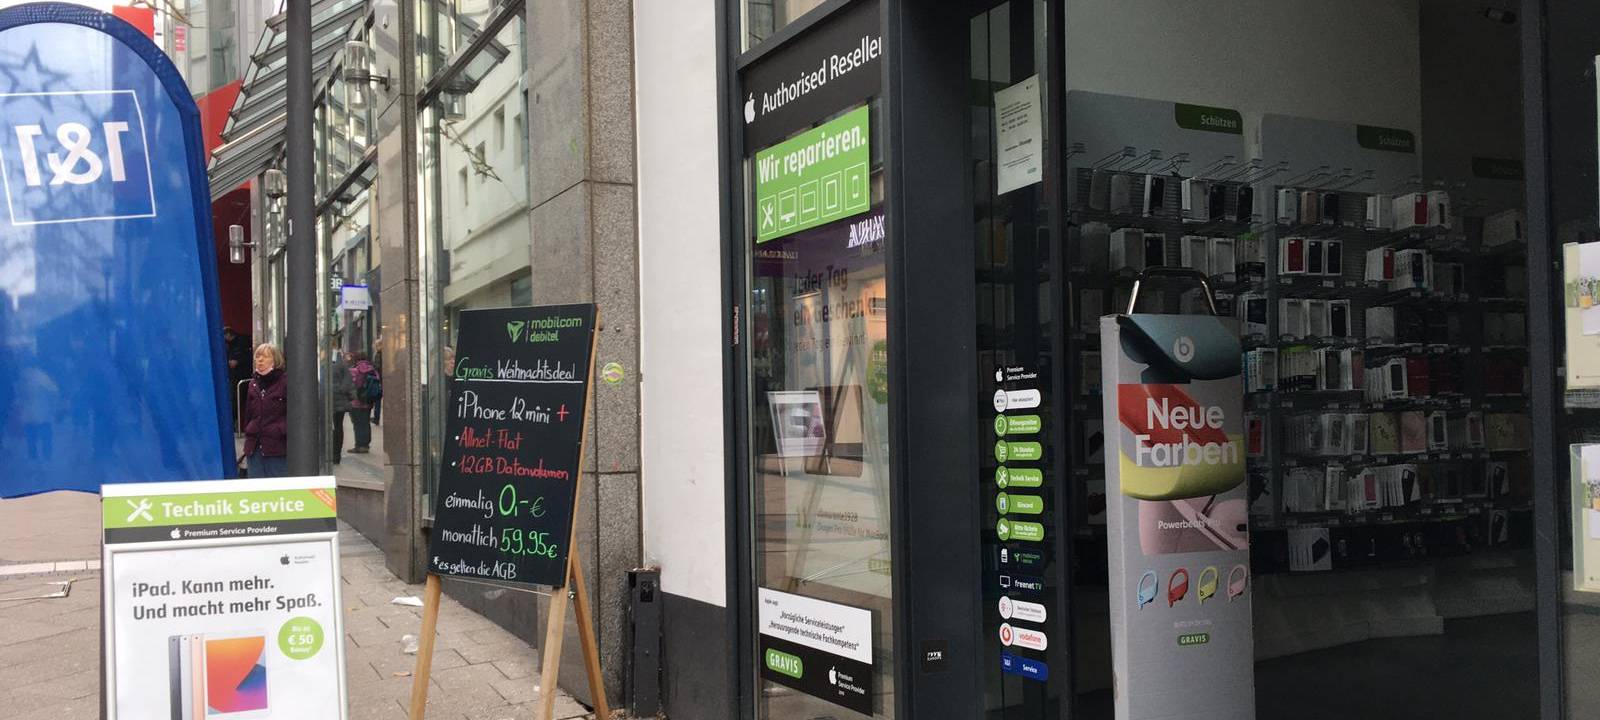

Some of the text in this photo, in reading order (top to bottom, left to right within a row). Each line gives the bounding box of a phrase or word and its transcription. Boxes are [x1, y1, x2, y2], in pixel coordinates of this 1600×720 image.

[762, 59, 826, 115] Authorised
[1200, 114, 1237, 128] Schützen
[758, 125, 866, 184] Wir reparieren.
[826, 264, 848, 291] Tag
[531, 316, 582, 329] mobilcom
[530, 330, 559, 342] debitel
[455, 357, 575, 381] Gravis Weihnachtsdeal
[458, 390, 506, 420] iPhone
[510, 396, 526, 421] 12
[525, 406, 551, 424] mini
[1147, 398, 1225, 430] Neue
[1136, 434, 1238, 467] Farben
[497, 458, 569, 480] Datenvolumen
[162, 499, 233, 518] Technik
[239, 497, 304, 514] Service
[445, 489, 494, 518] einmalig
[184, 526, 277, 537] Premium Service Provider
[442, 524, 498, 548] monatlich
[450, 559, 475, 574] gelten
[477, 562, 490, 576] die
[491, 560, 517, 579] AGB
[132, 576, 275, 598] iPad. Kann mehr.
[133, 593, 322, 621] Und macht mehr Spaß.
[298, 633, 314, 645] 50
[1180, 635, 1207, 644] GRAVIS
[770, 653, 798, 674] GRAVIS
[1022, 664, 1038, 674] Service
